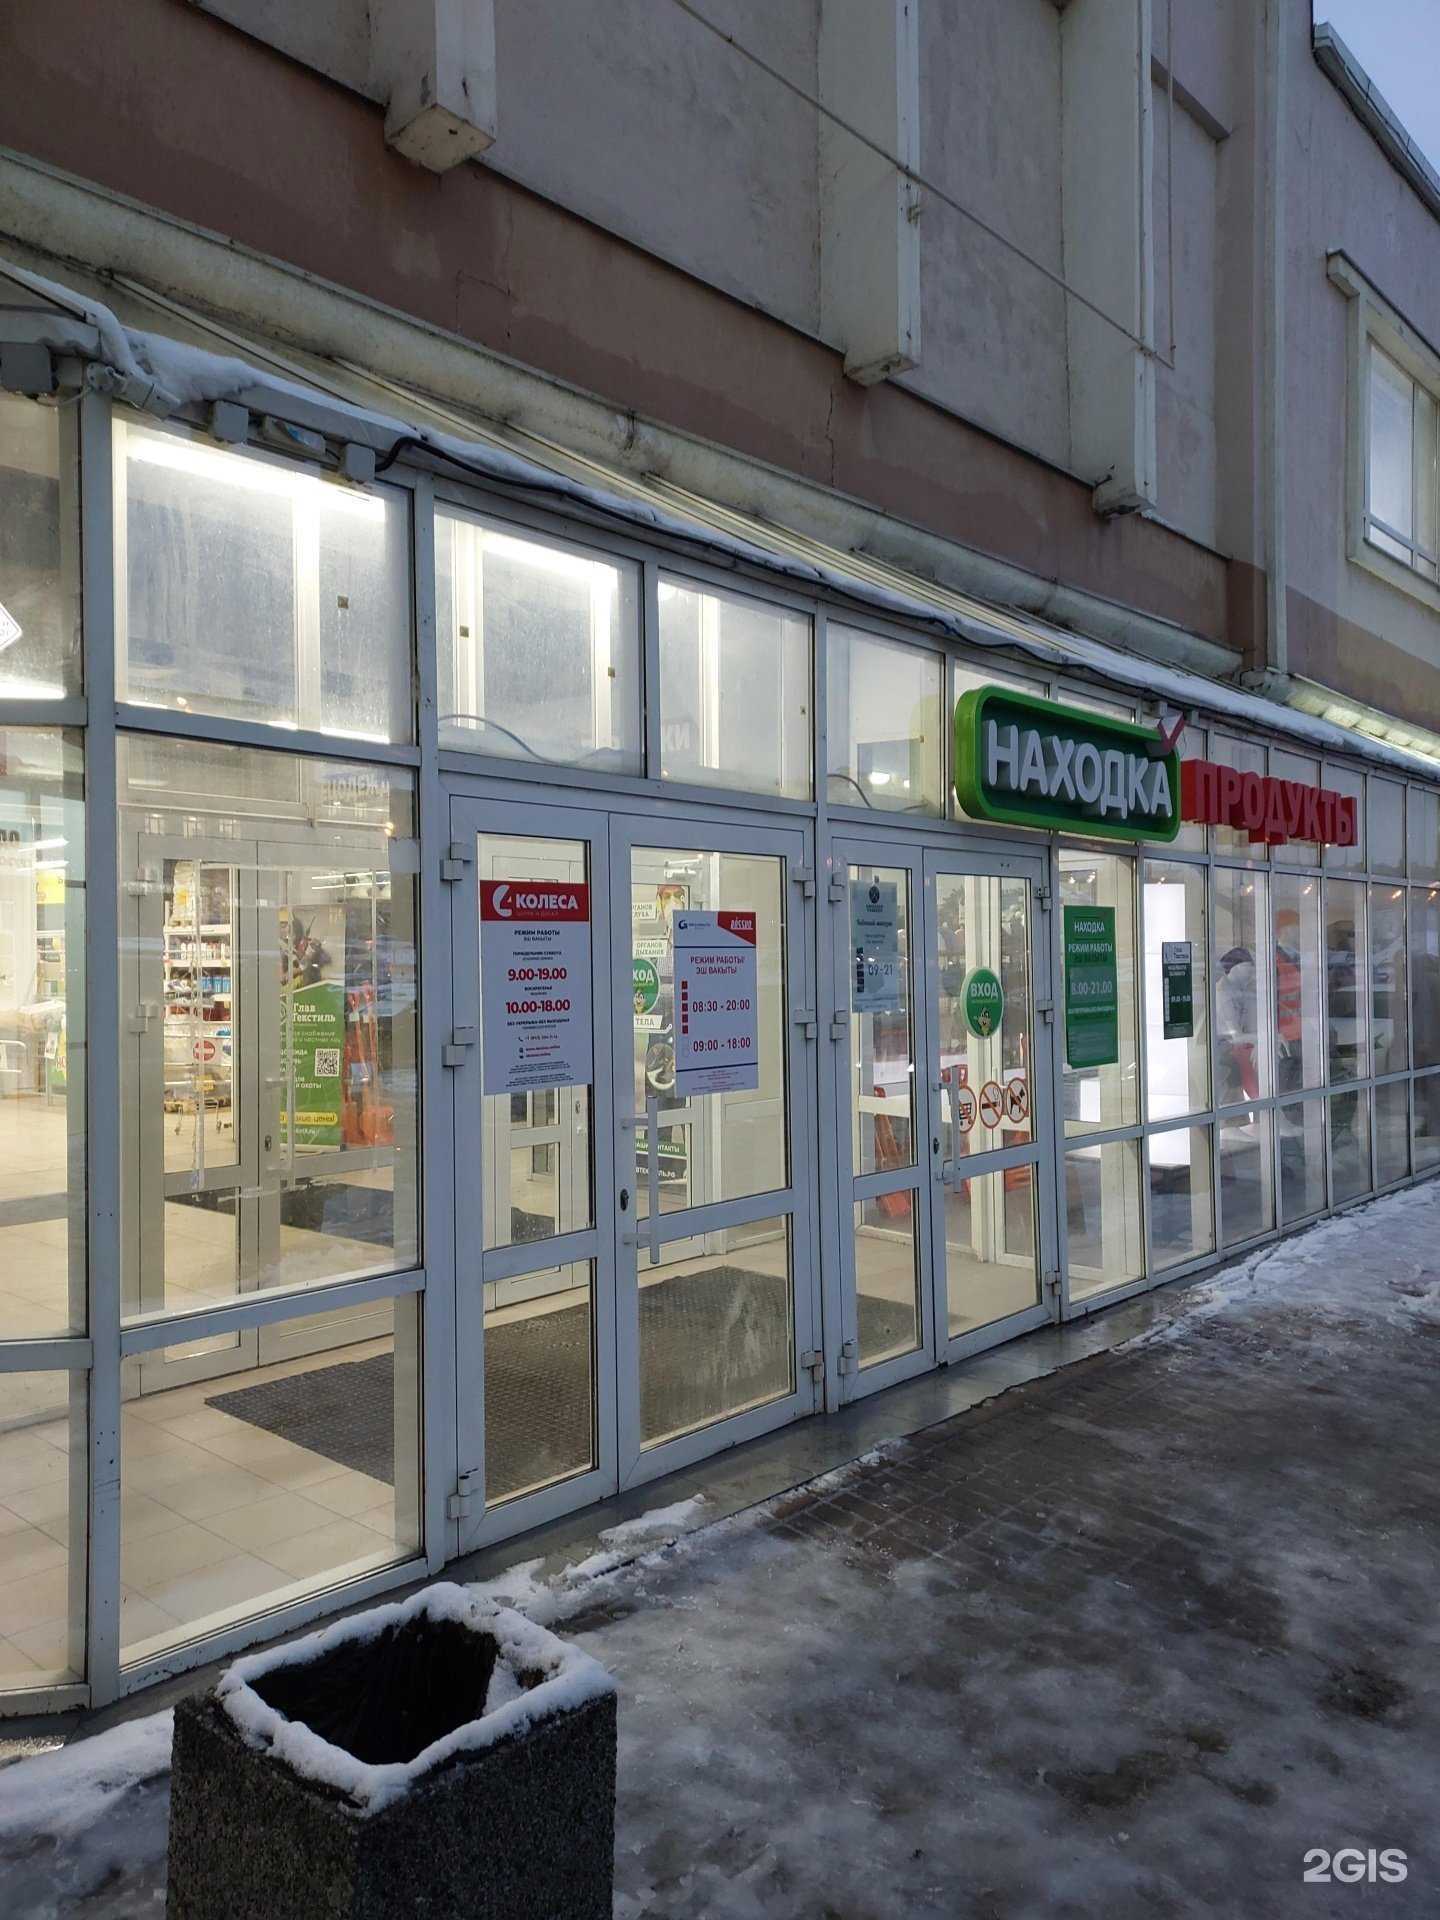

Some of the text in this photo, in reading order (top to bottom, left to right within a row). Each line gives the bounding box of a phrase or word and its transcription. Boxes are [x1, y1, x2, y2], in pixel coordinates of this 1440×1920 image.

[983, 719, 1173, 820] НАХОДКА
[1186, 760, 1358, 847] ПРОДУКТЫ
[515, 893, 579, 910] КОЛЕСА
[1074, 921, 1105, 934] НАХОДКА
[690, 955, 715, 964] РЕЖИМ
[508, 968, 567, 981] 9.00-19.00
[632, 969, 655, 983] ХОД
[970, 982, 999, 1000] ВХОД
[505, 999, 571, 1014] 10.00-18.00
[692, 1001, 718, 1013] 08:30
[726, 999, 750, 1011] 20:00
[693, 1040, 718, 1052] 09:00
[727, 1037, 751, 1049] 18:00
